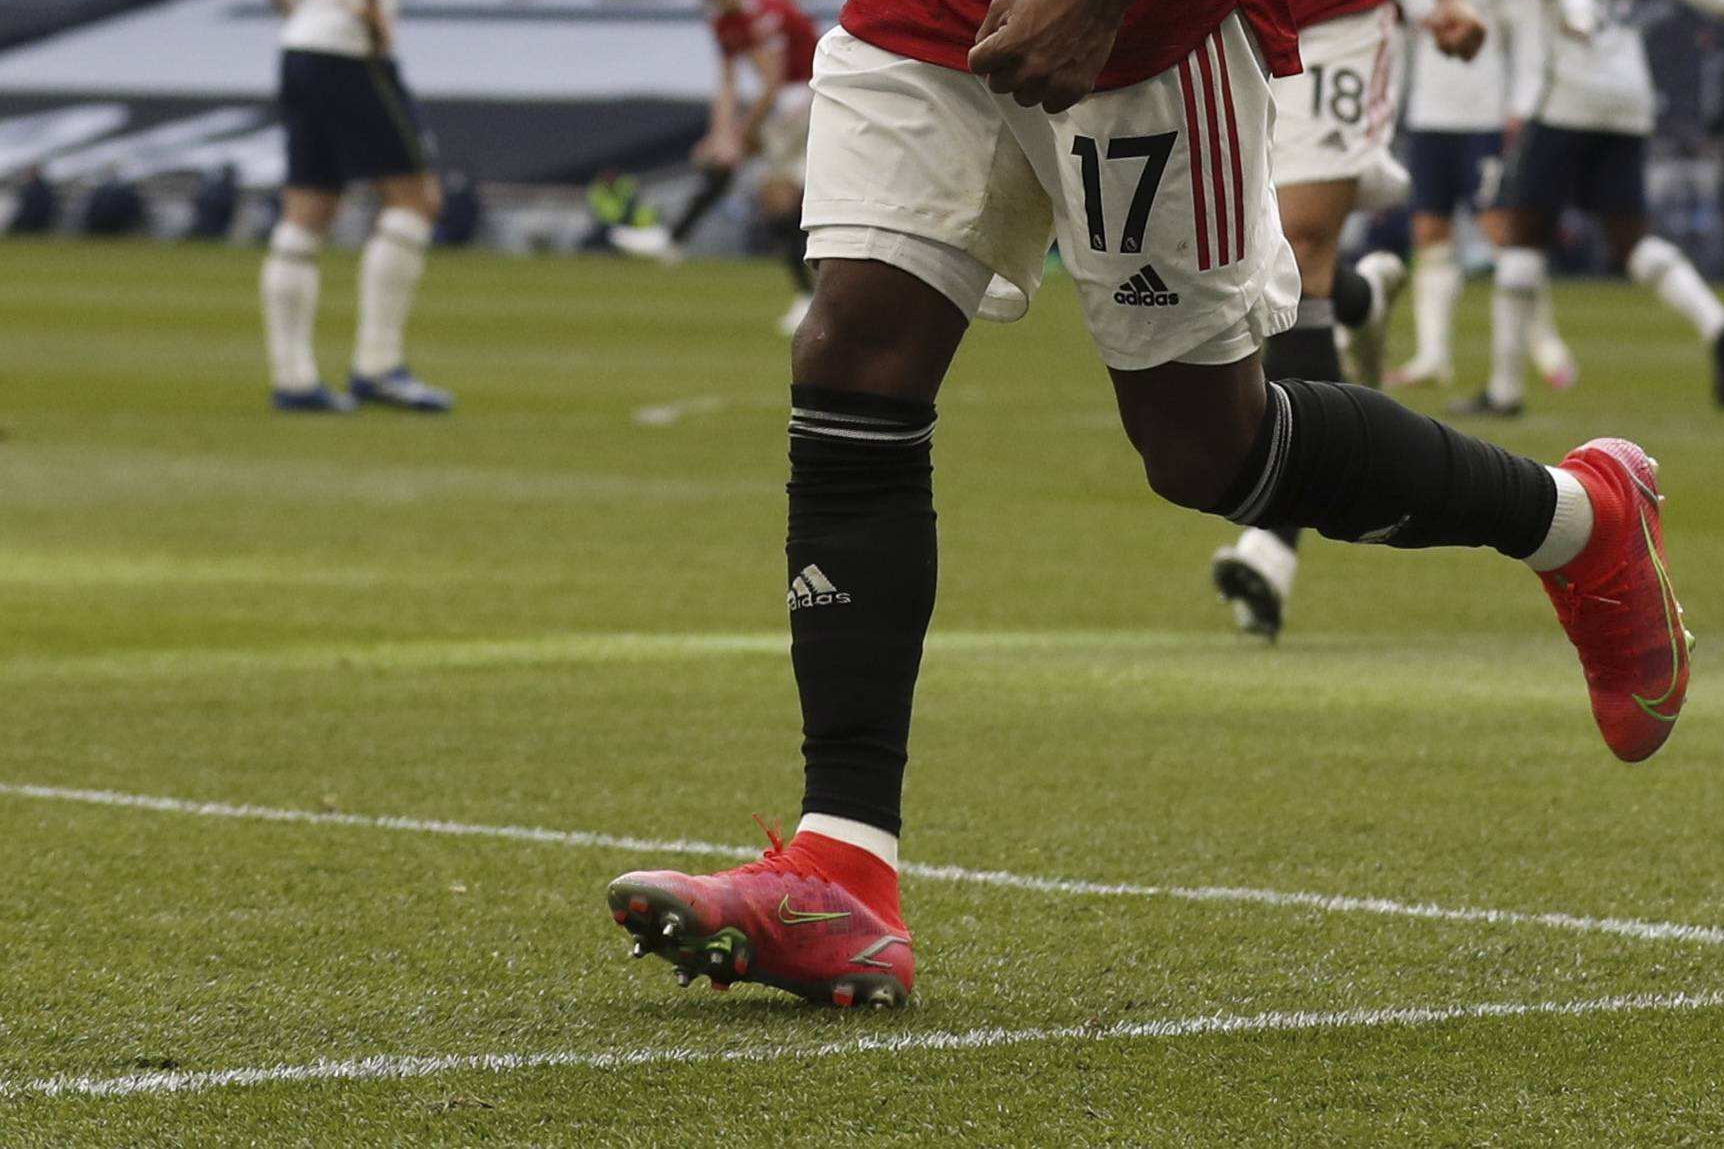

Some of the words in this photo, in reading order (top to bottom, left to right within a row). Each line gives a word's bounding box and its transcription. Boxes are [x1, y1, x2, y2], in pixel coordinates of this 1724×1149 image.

[1307, 63, 1366, 126] 18
[1070, 130, 1179, 254] 17
[1113, 289, 1180, 308] adidas
